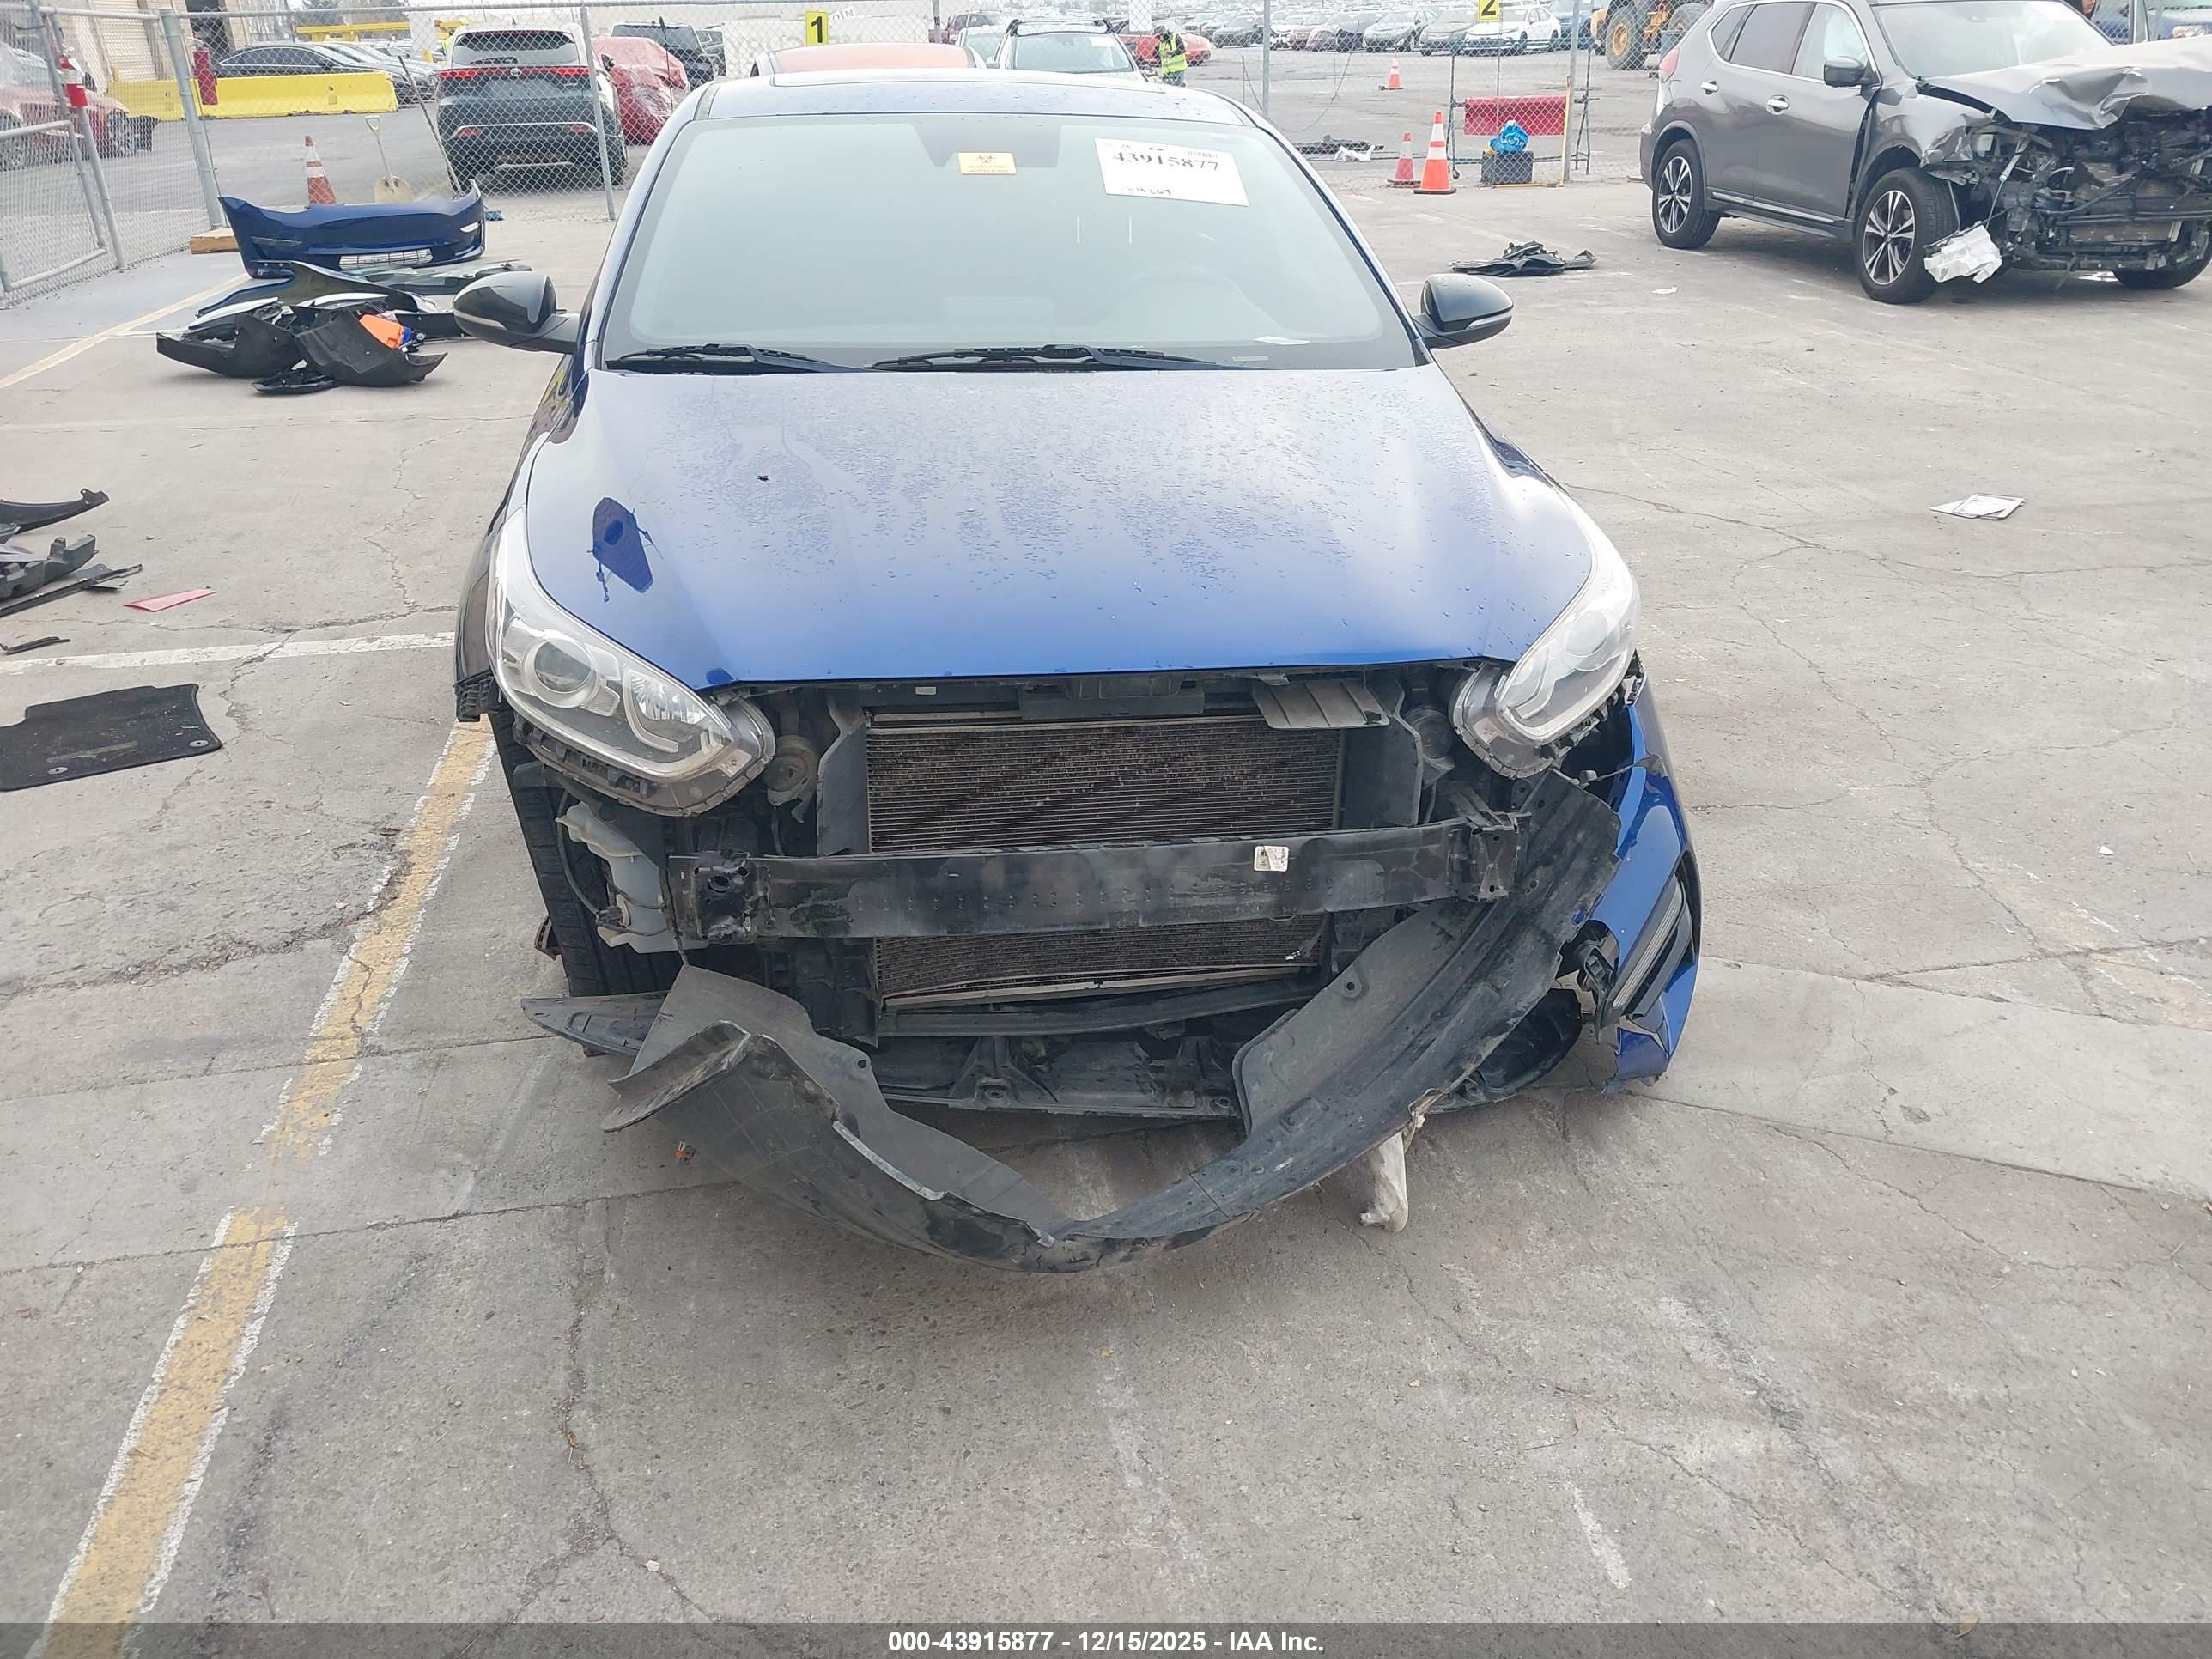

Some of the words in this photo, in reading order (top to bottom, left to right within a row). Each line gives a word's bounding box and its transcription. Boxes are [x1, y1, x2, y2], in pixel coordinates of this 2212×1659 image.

[1480, 0, 1497, 16] 2
[811, 15, 823, 44] 1
[1113, 151, 1219, 172] 43915877
